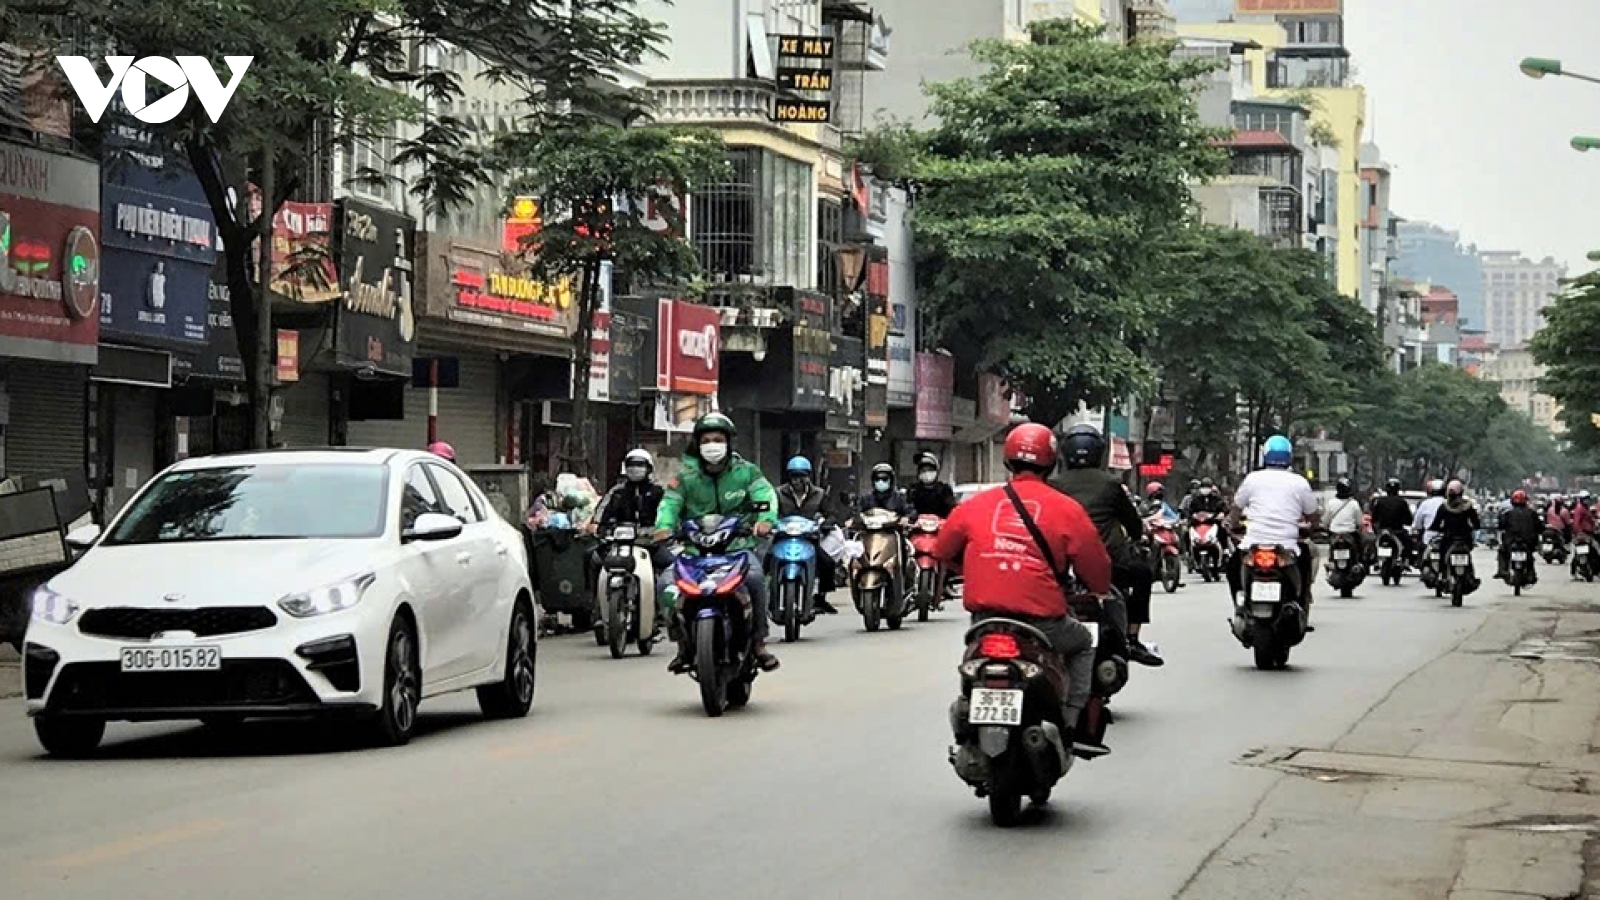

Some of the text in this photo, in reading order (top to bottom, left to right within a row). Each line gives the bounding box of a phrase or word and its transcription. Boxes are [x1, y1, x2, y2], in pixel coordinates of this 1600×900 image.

[781, 38, 831, 55] XE MÁY
[124, 649, 217, 668] 30G-015.82
